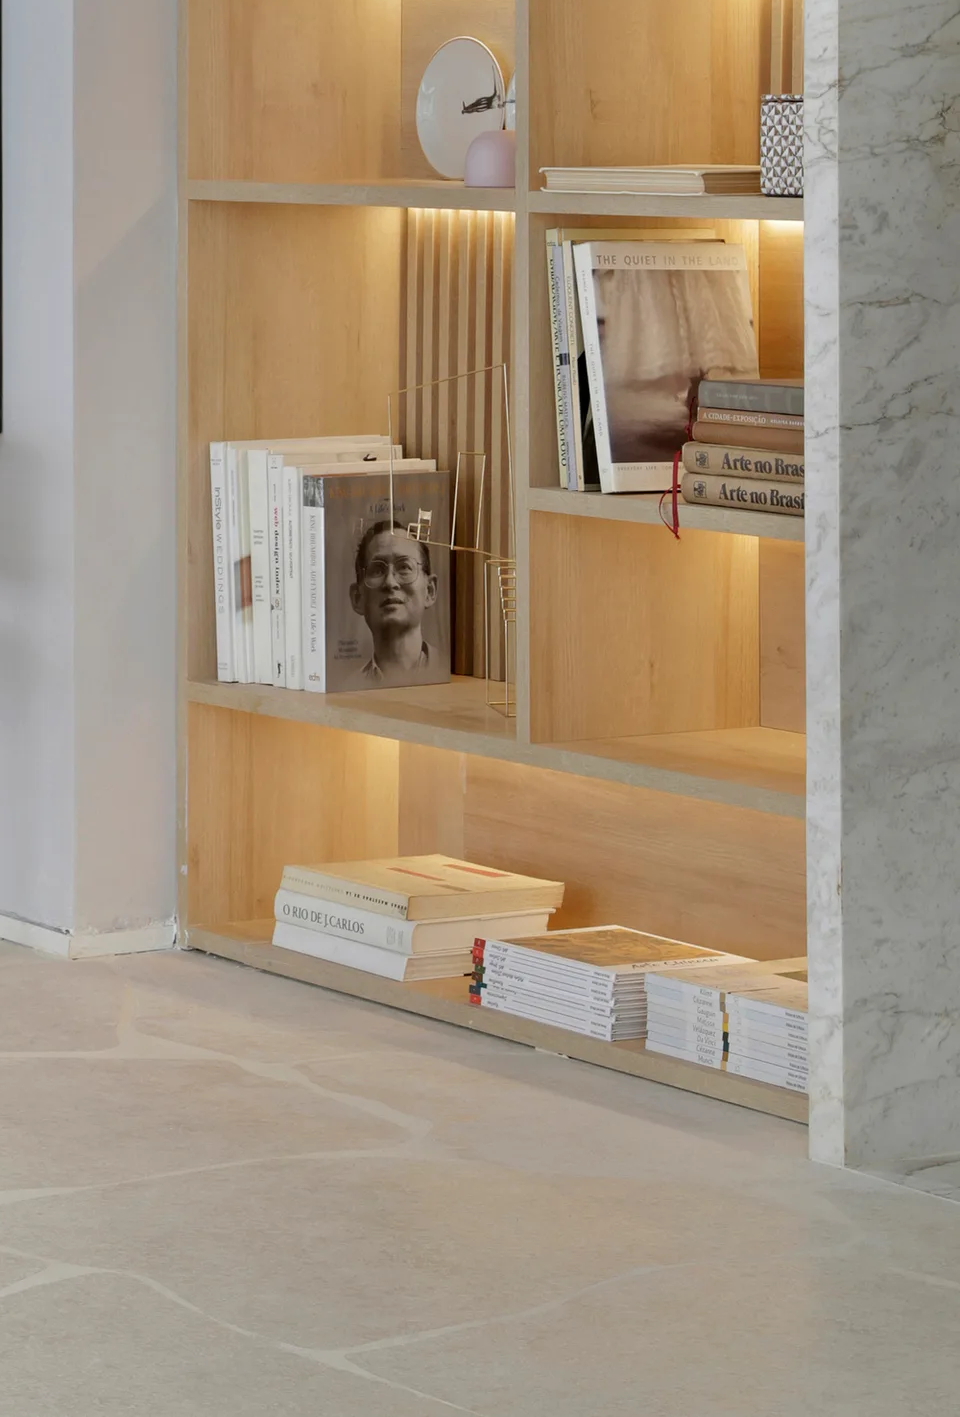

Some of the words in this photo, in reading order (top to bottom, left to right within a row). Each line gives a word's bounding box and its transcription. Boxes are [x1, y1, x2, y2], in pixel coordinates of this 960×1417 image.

[596, 254, 617, 266] THE
[624, 255, 657, 266] QUIET
[664, 256, 676, 266] IN
[682, 256, 703, 266] THE
[709, 256, 740, 266] LAND
[566, 275, 574, 310] ELOQUENT
[703, 412, 708, 420] A
[708, 412, 766, 426] CIDADE-EXPOSIÇÃO
[721, 452, 752, 471] Arte
[754, 462, 772, 474] no
[718, 483, 748, 502] Arte
[750, 492, 768, 506] no
[214, 486, 222, 530] InStyle
[216, 533, 225, 614] WEDDINGS
[282, 904, 290, 916] O
[292, 906, 308, 921] RIO
[310, 910, 322, 924] DE
[692, 995, 713, 1007] Cézanne
[696, 1006, 716, 1018] Gauguin
[692, 1024, 716, 1038] Velázquez
[696, 1036, 704, 1044] Da
[704, 1036, 716, 1047] Vinci
[696, 1045, 716, 1056] Cézanne
[698, 1055, 714, 1065] Munch
